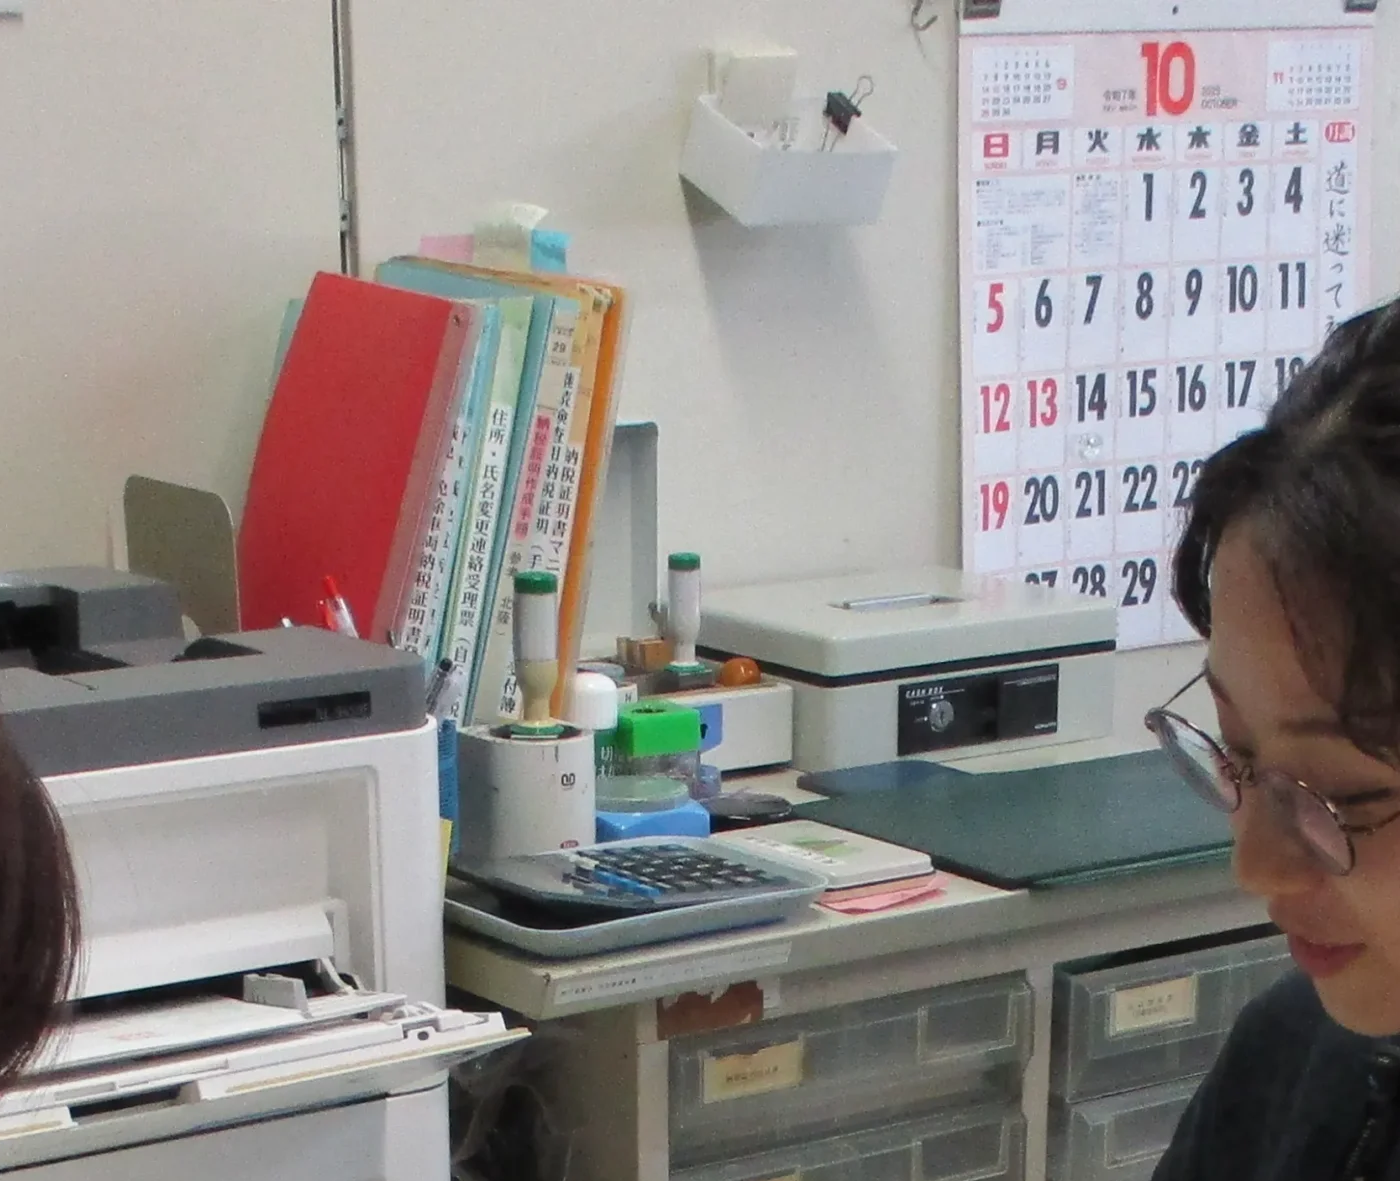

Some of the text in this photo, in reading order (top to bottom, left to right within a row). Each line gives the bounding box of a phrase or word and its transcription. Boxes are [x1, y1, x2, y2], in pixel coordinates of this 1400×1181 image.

[1141, 41, 1197, 117] 10
[983, 133, 1010, 158] 日
[1036, 131, 1060, 155] 月
[1087, 129, 1109, 153] 火
[1136, 127, 1161, 151] 水
[1187, 125, 1211, 149] 木
[1237, 123, 1260, 147] 金
[1285, 122, 1308, 145] 土
[1143, 173, 1154, 222] 1
[1189, 170, 1207, 219] 2
[1237, 168, 1254, 217] 3
[1284, 166, 1304, 214] 4
[986, 262, 1307, 333] 5 6 7 8 9 10 11
[980, 383, 1010, 434] 12
[1027, 378, 1058, 428] 13
[1076, 373, 1107, 423] 14
[1126, 369, 1157, 418] 15
[1176, 365, 1206, 413] 16
[1225, 360, 1256, 408] 17
[980, 481, 1009, 531] 19
[1024, 475, 1059, 526] 20
[1075, 470, 1106, 519] 21
[1122, 465, 1157, 513] 22
[1122, 558, 1157, 608] 29
